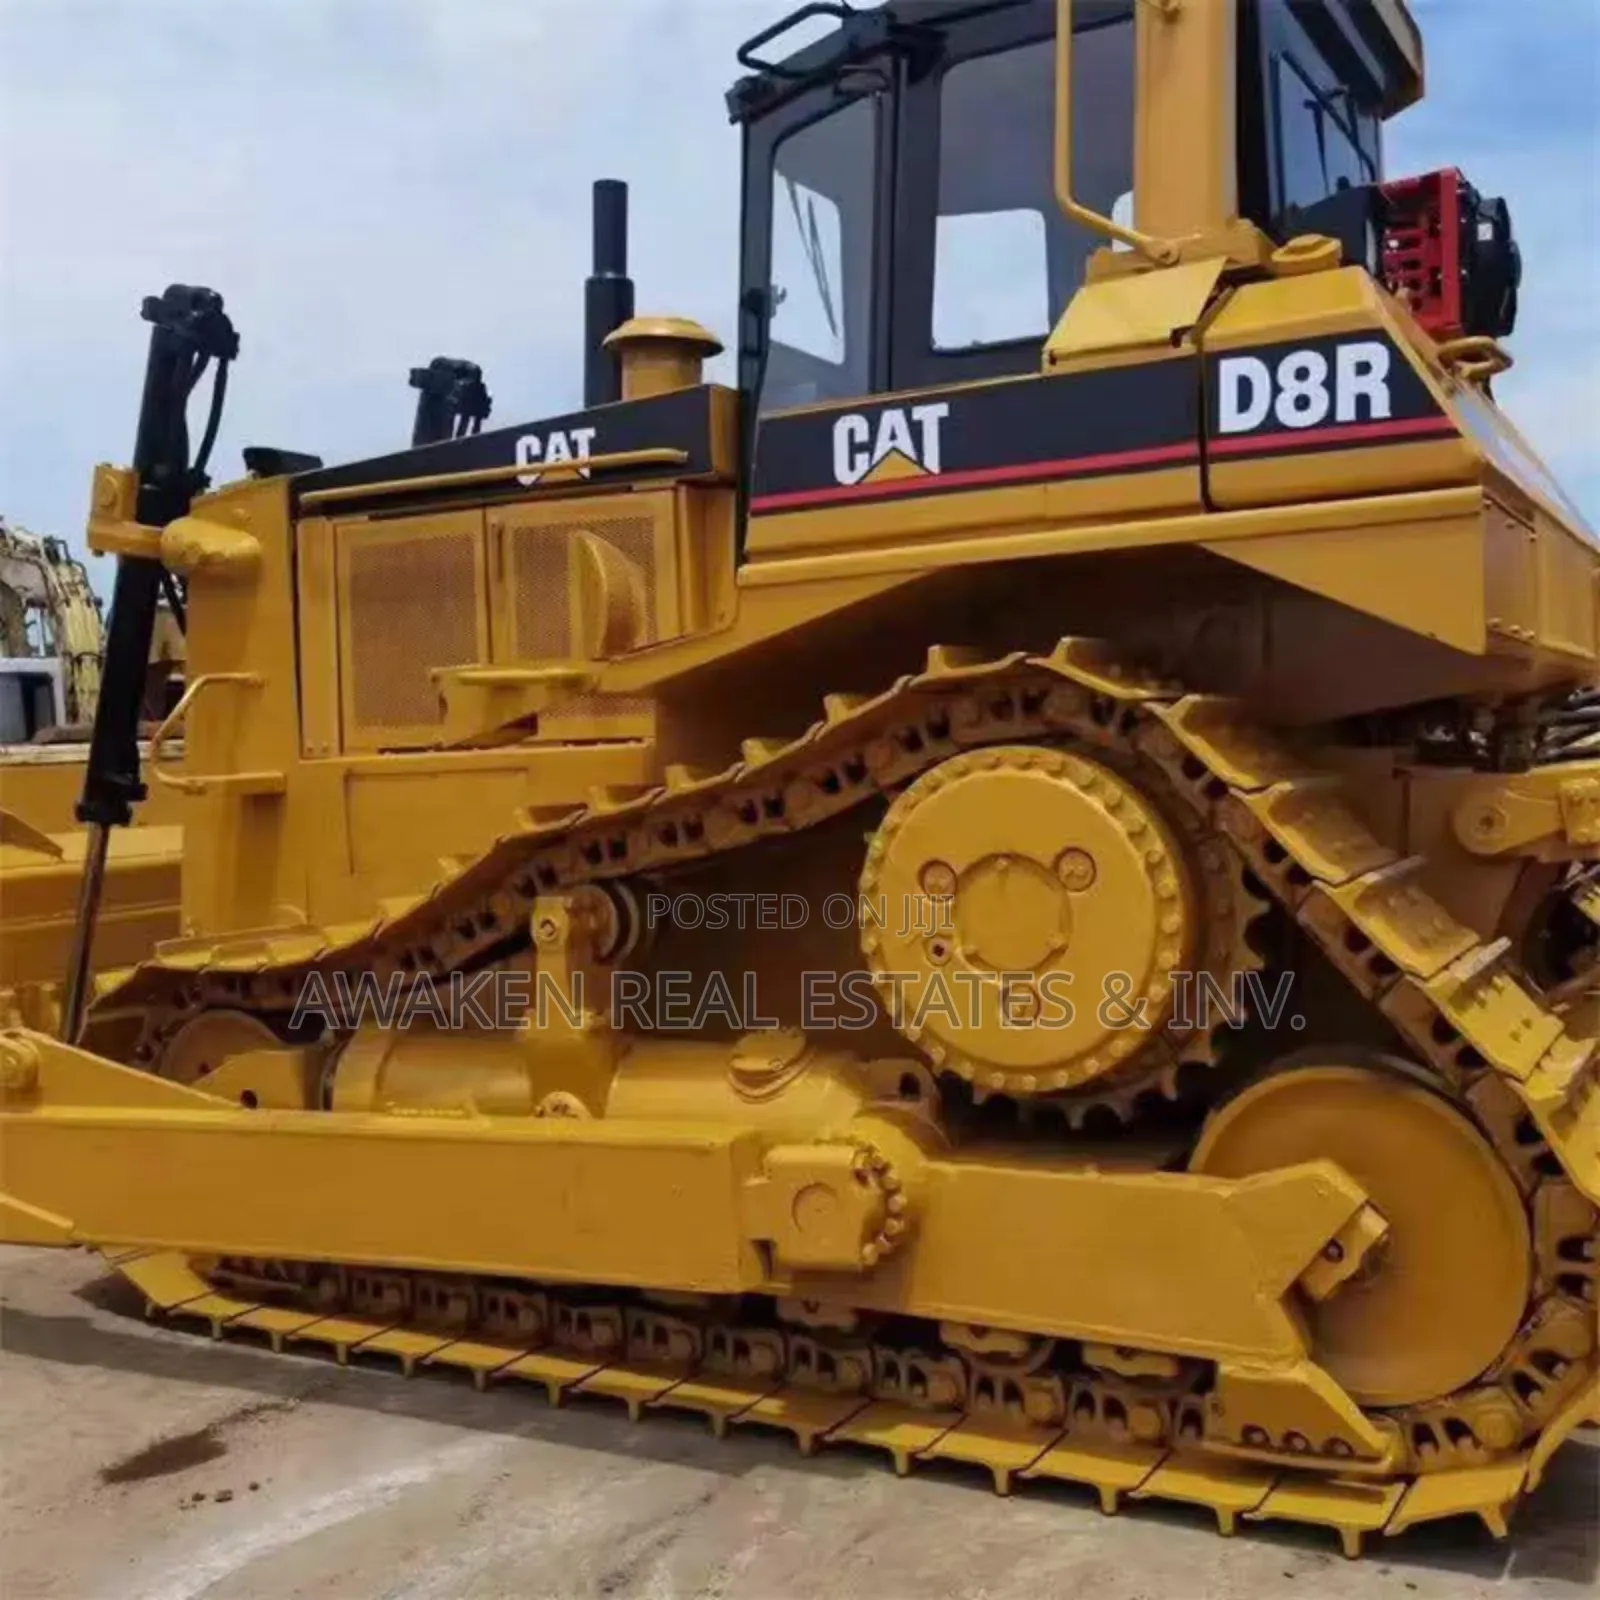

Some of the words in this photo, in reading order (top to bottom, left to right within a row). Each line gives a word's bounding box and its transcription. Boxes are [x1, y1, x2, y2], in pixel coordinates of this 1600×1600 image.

[1219, 341, 1391, 433] D8R
[515, 427, 597, 486] CAT
[833, 402, 949, 486] CAT
